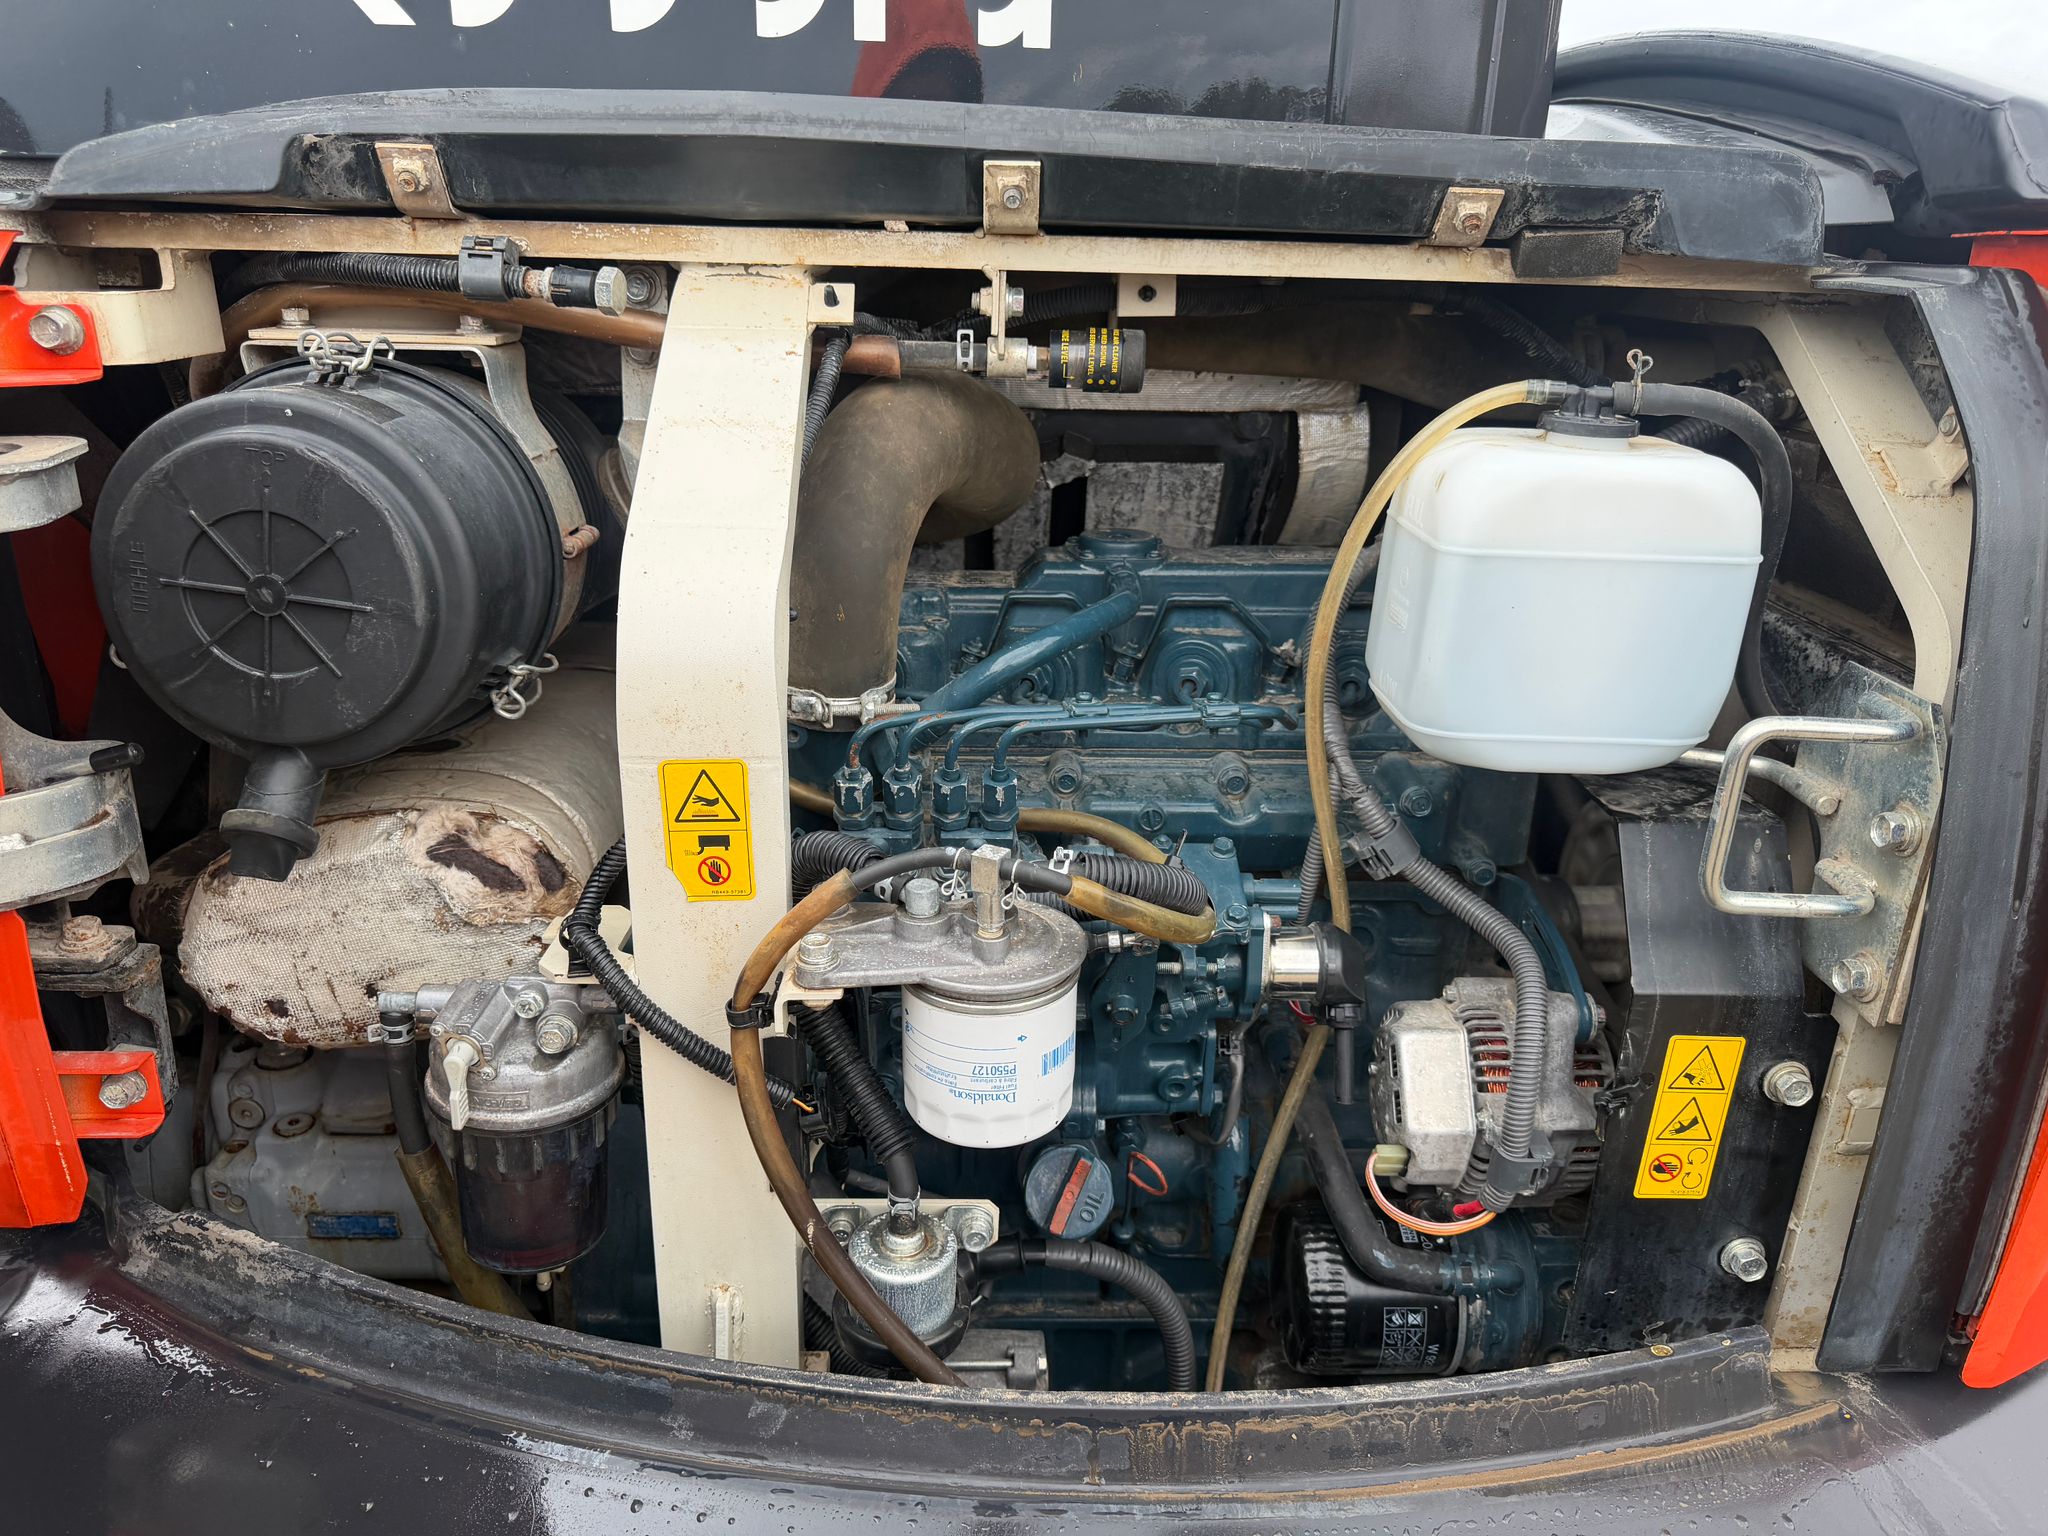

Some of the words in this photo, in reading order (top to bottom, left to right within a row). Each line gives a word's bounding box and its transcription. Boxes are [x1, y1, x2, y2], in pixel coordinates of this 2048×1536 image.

[1061, 343, 1069, 364] LEVEL
[1088, 334, 1096, 357] SERVICE
[1099, 345, 1107, 368] SIGNAL
[1111, 345, 1120, 373] CLEANER
[971, 1064, 1017, 1076] P550127
[1079, 1191, 1105, 1223] OIL
